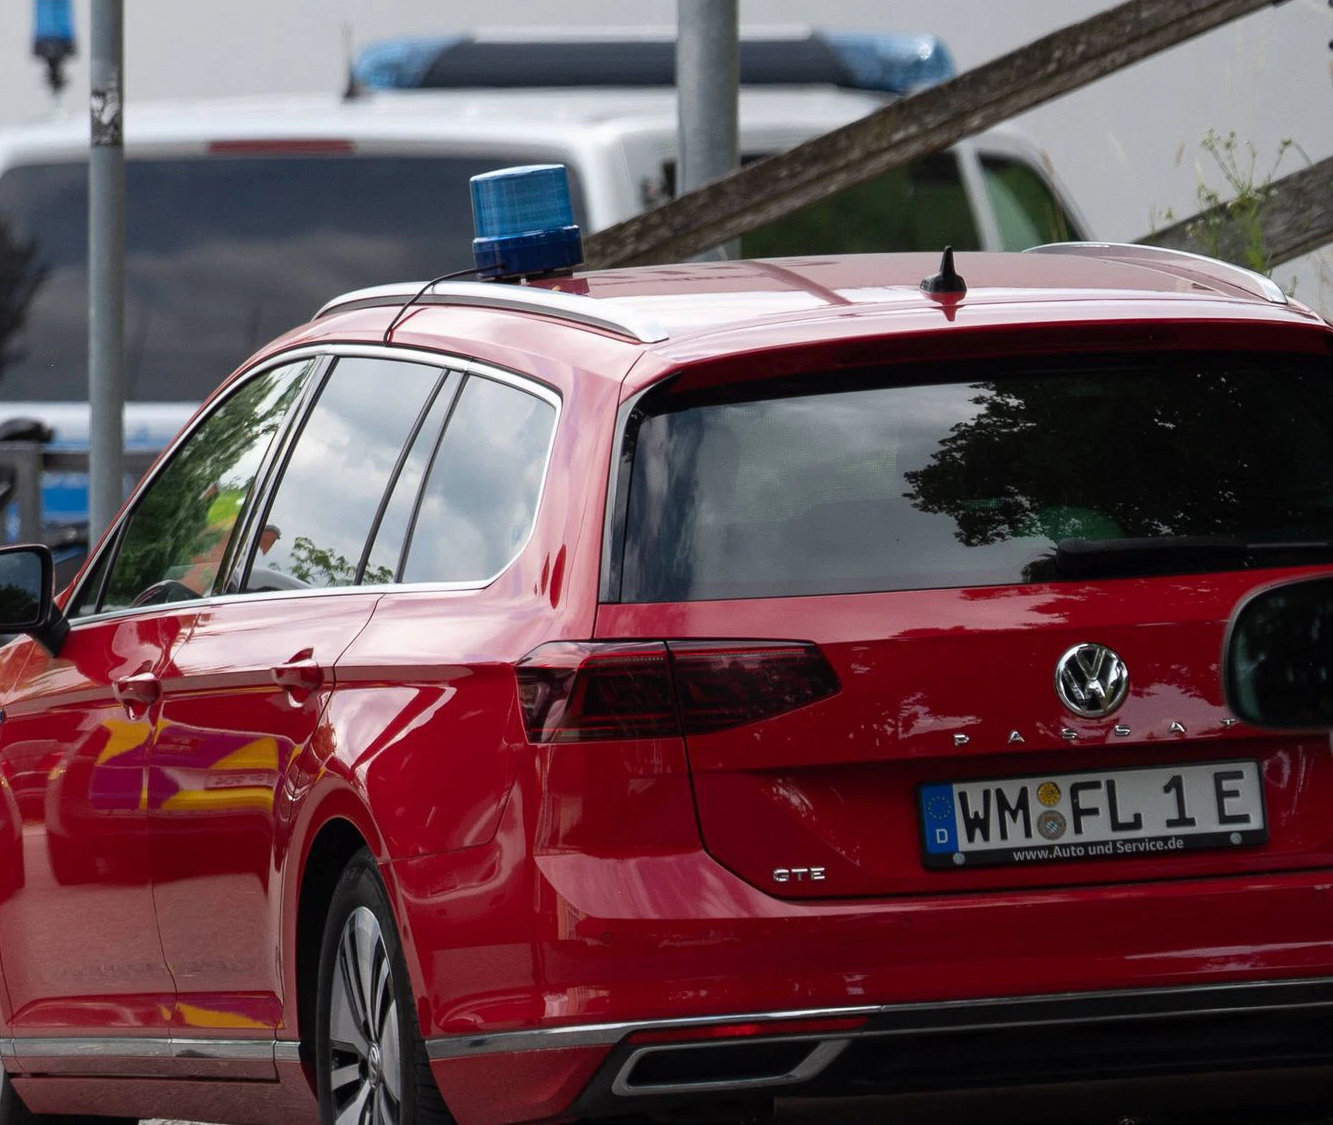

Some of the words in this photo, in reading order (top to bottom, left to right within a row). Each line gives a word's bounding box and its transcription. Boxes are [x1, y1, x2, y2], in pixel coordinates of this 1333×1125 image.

[936, 828, 949, 844] D
[958, 786, 1033, 843] WM
[1069, 779, 1143, 835] FL
[1163, 775, 1196, 828] 1
[1214, 770, 1251, 825] E
[1013, 846, 1084, 862] www.Auto
[1088, 842, 1113, 856] und
[1116, 837, 1184, 855] Service.de
[773, 867, 825, 881] GTE
